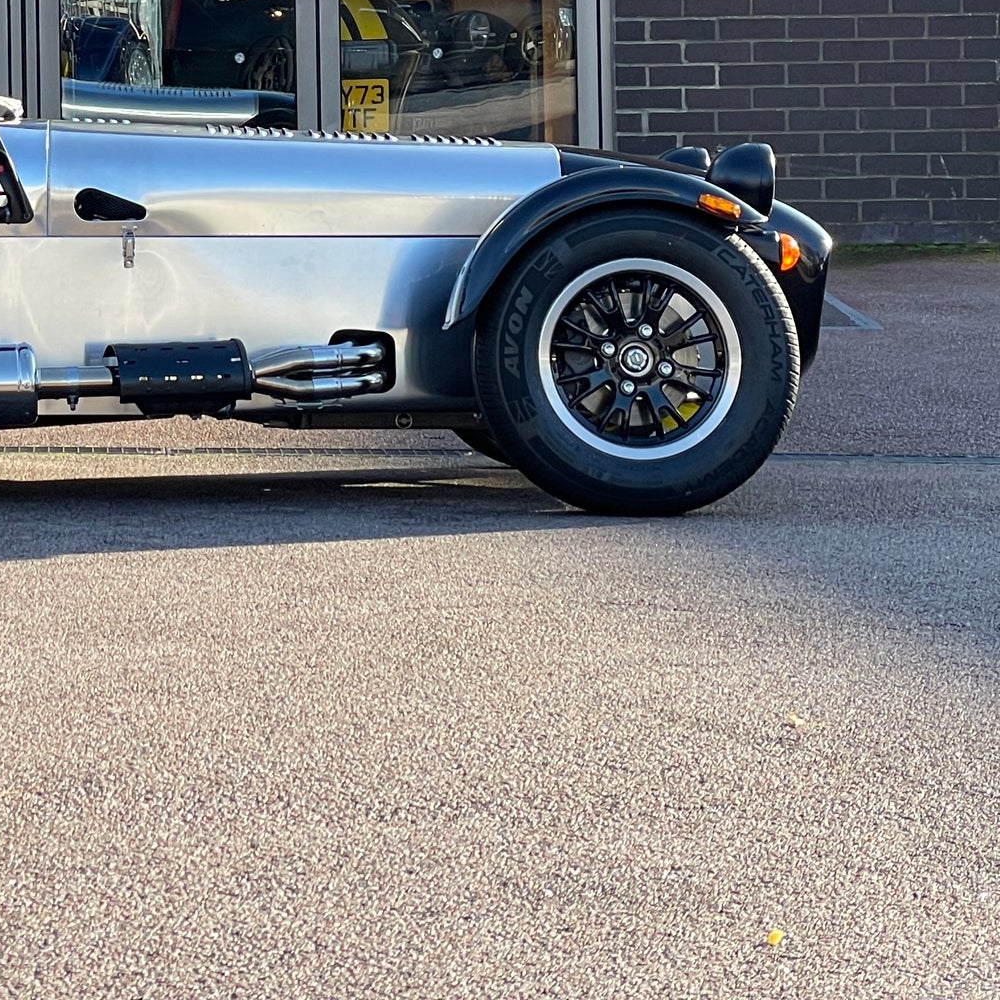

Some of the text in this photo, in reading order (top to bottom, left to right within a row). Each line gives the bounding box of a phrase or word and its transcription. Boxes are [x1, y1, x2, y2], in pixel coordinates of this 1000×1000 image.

[341, 85, 385, 105] Y73
[341, 108, 377, 128] TF
[503, 284, 536, 380] AVON
[716, 248, 785, 382] CATERHAM
